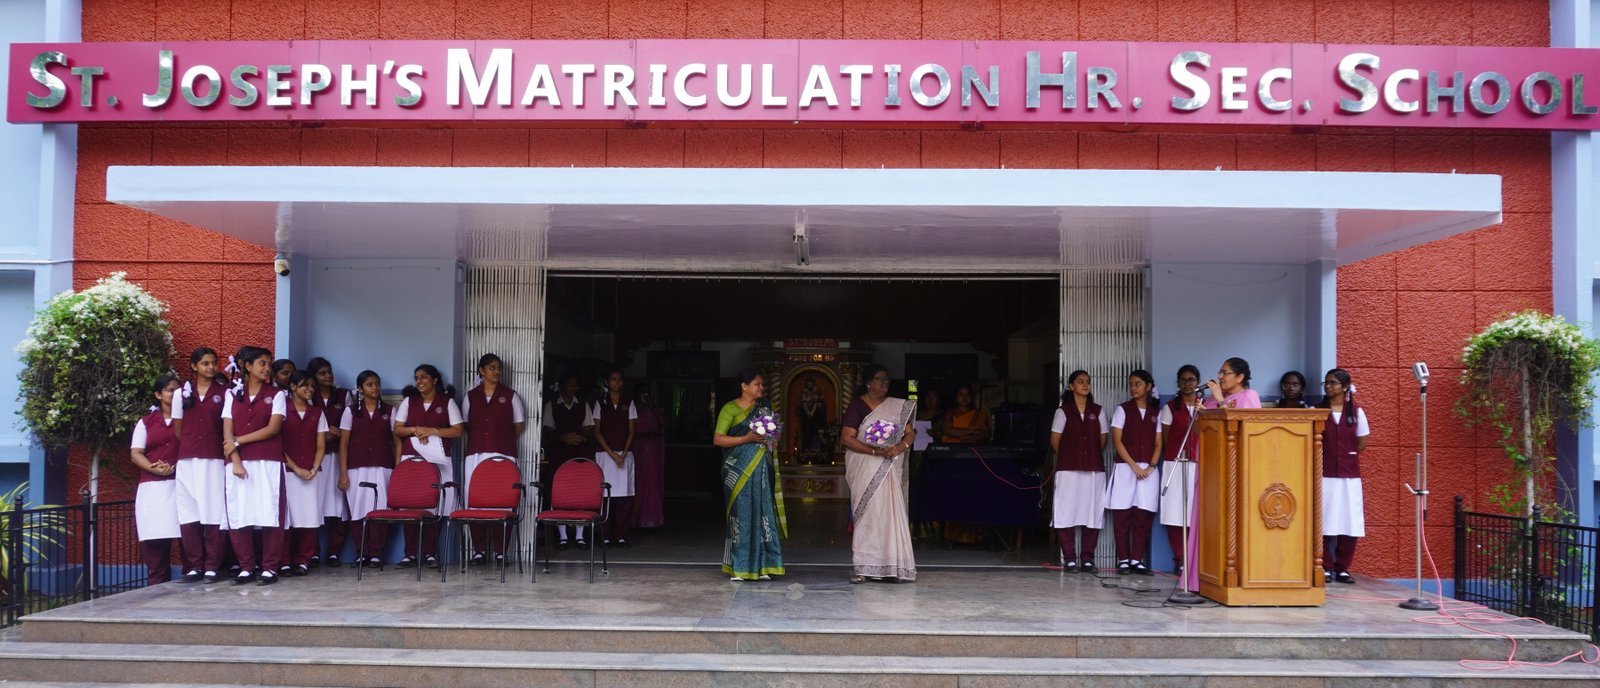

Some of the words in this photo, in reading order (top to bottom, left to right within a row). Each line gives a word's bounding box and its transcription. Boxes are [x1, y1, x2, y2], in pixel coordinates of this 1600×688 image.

[26, 51, 118, 109] ST.
[142, 49, 424, 108] JOSEPH'S
[446, 48, 1000, 107] MATRICULATION
[1025, 51, 1143, 110] HR.
[1170, 51, 1312, 113] SEC.
[1338, 52, 1598, 116] SCHOOL
